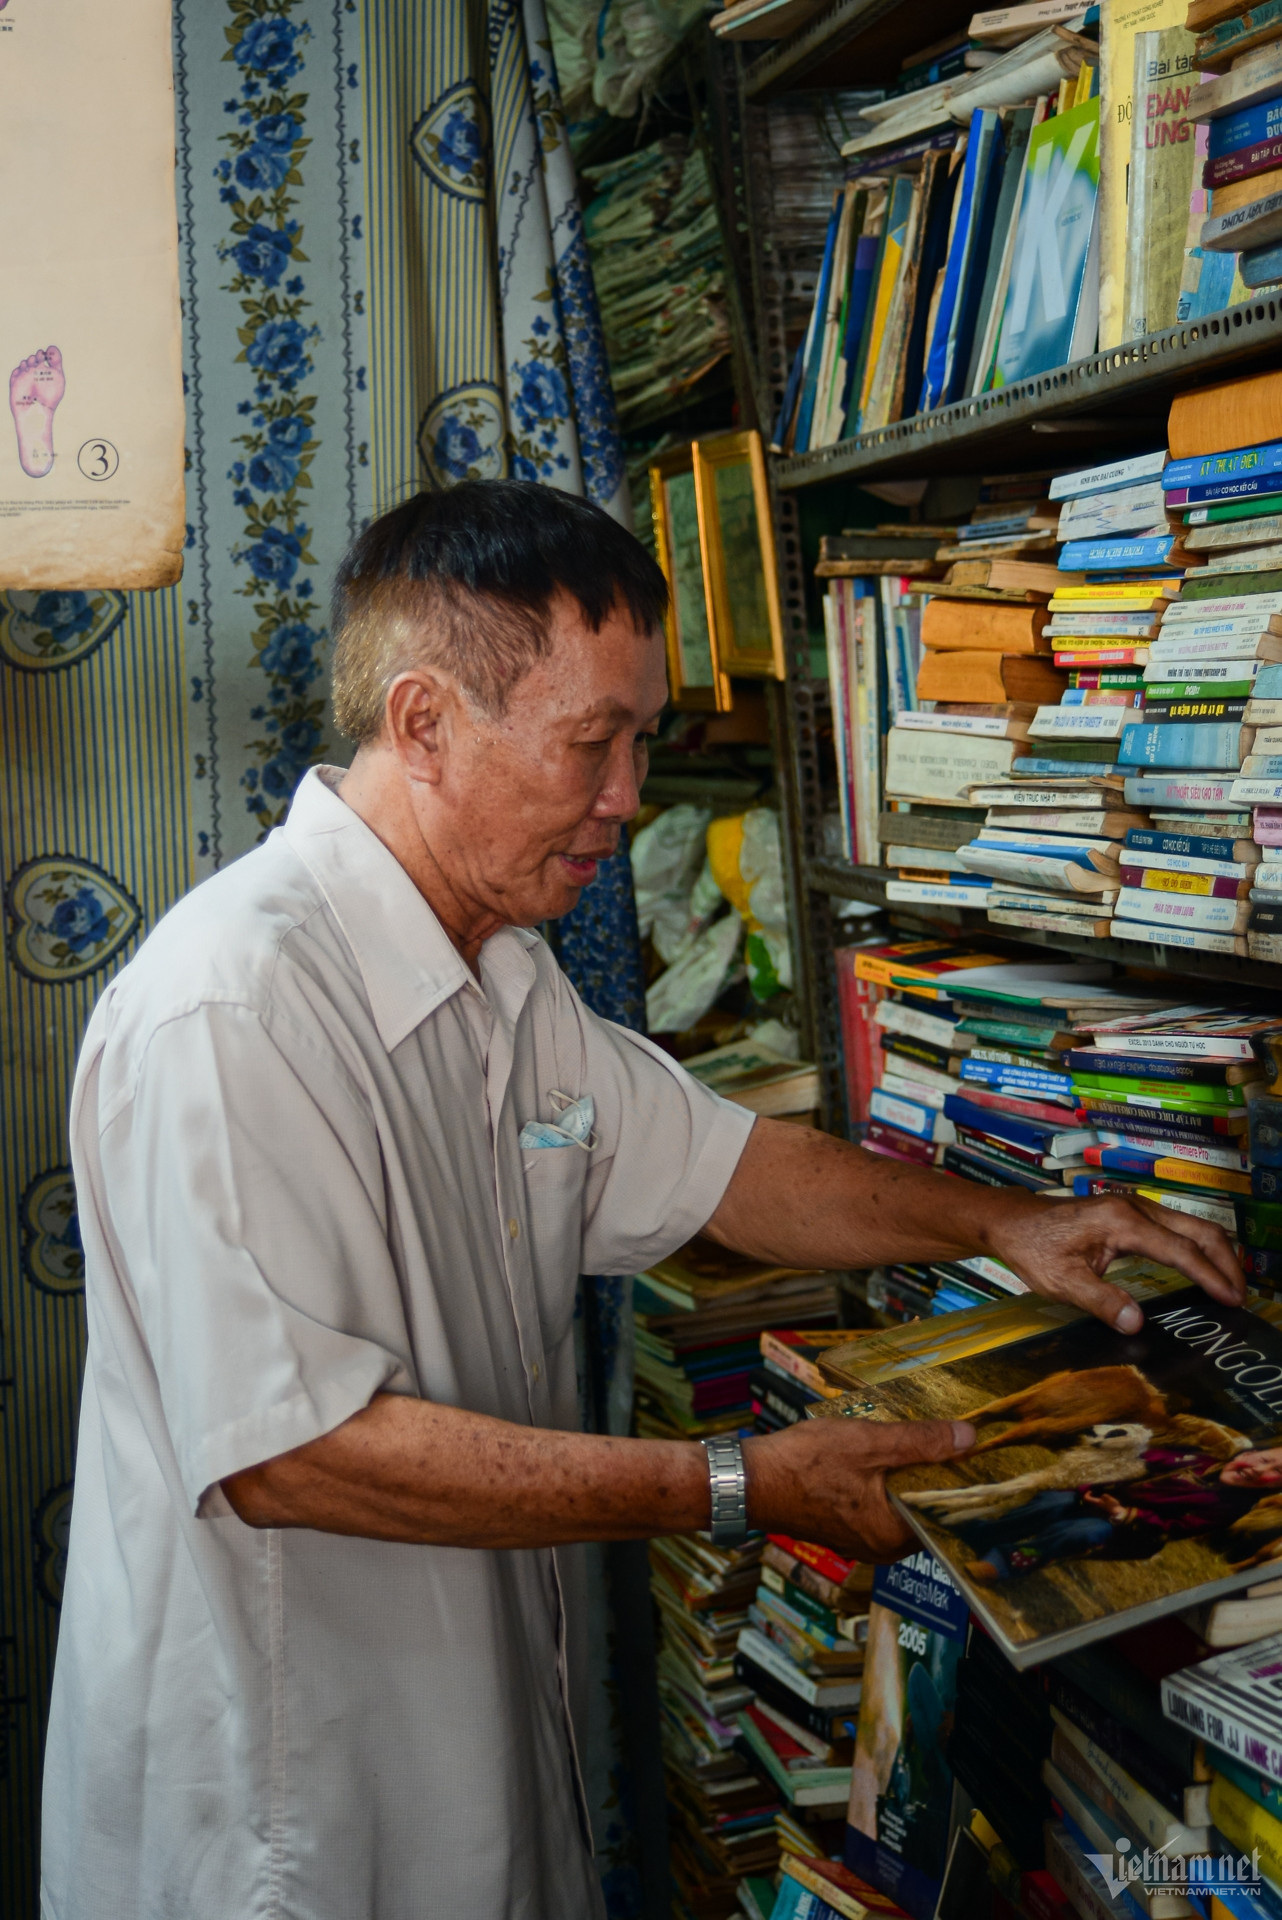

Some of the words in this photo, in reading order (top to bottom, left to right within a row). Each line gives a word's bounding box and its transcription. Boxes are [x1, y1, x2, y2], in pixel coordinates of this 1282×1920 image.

[90, 444, 108, 477] 3
[1025, 792, 1039, 803] TRÚC
[1128, 1038, 1142, 1046] EXCEL
[1164, 1040, 1175, 1048] CHO
[1173, 1142, 1199, 1158] Premiere
[1198, 1147, 1209, 1161] Pro
[897, 1622, 928, 1657] 2005
[1167, 1689, 1206, 1733] LOOKING
[1206, 1712, 1225, 1746] FOR
[1227, 1725, 1240, 1753] JJ
[1244, 1733, 1271, 1773] ANNE
